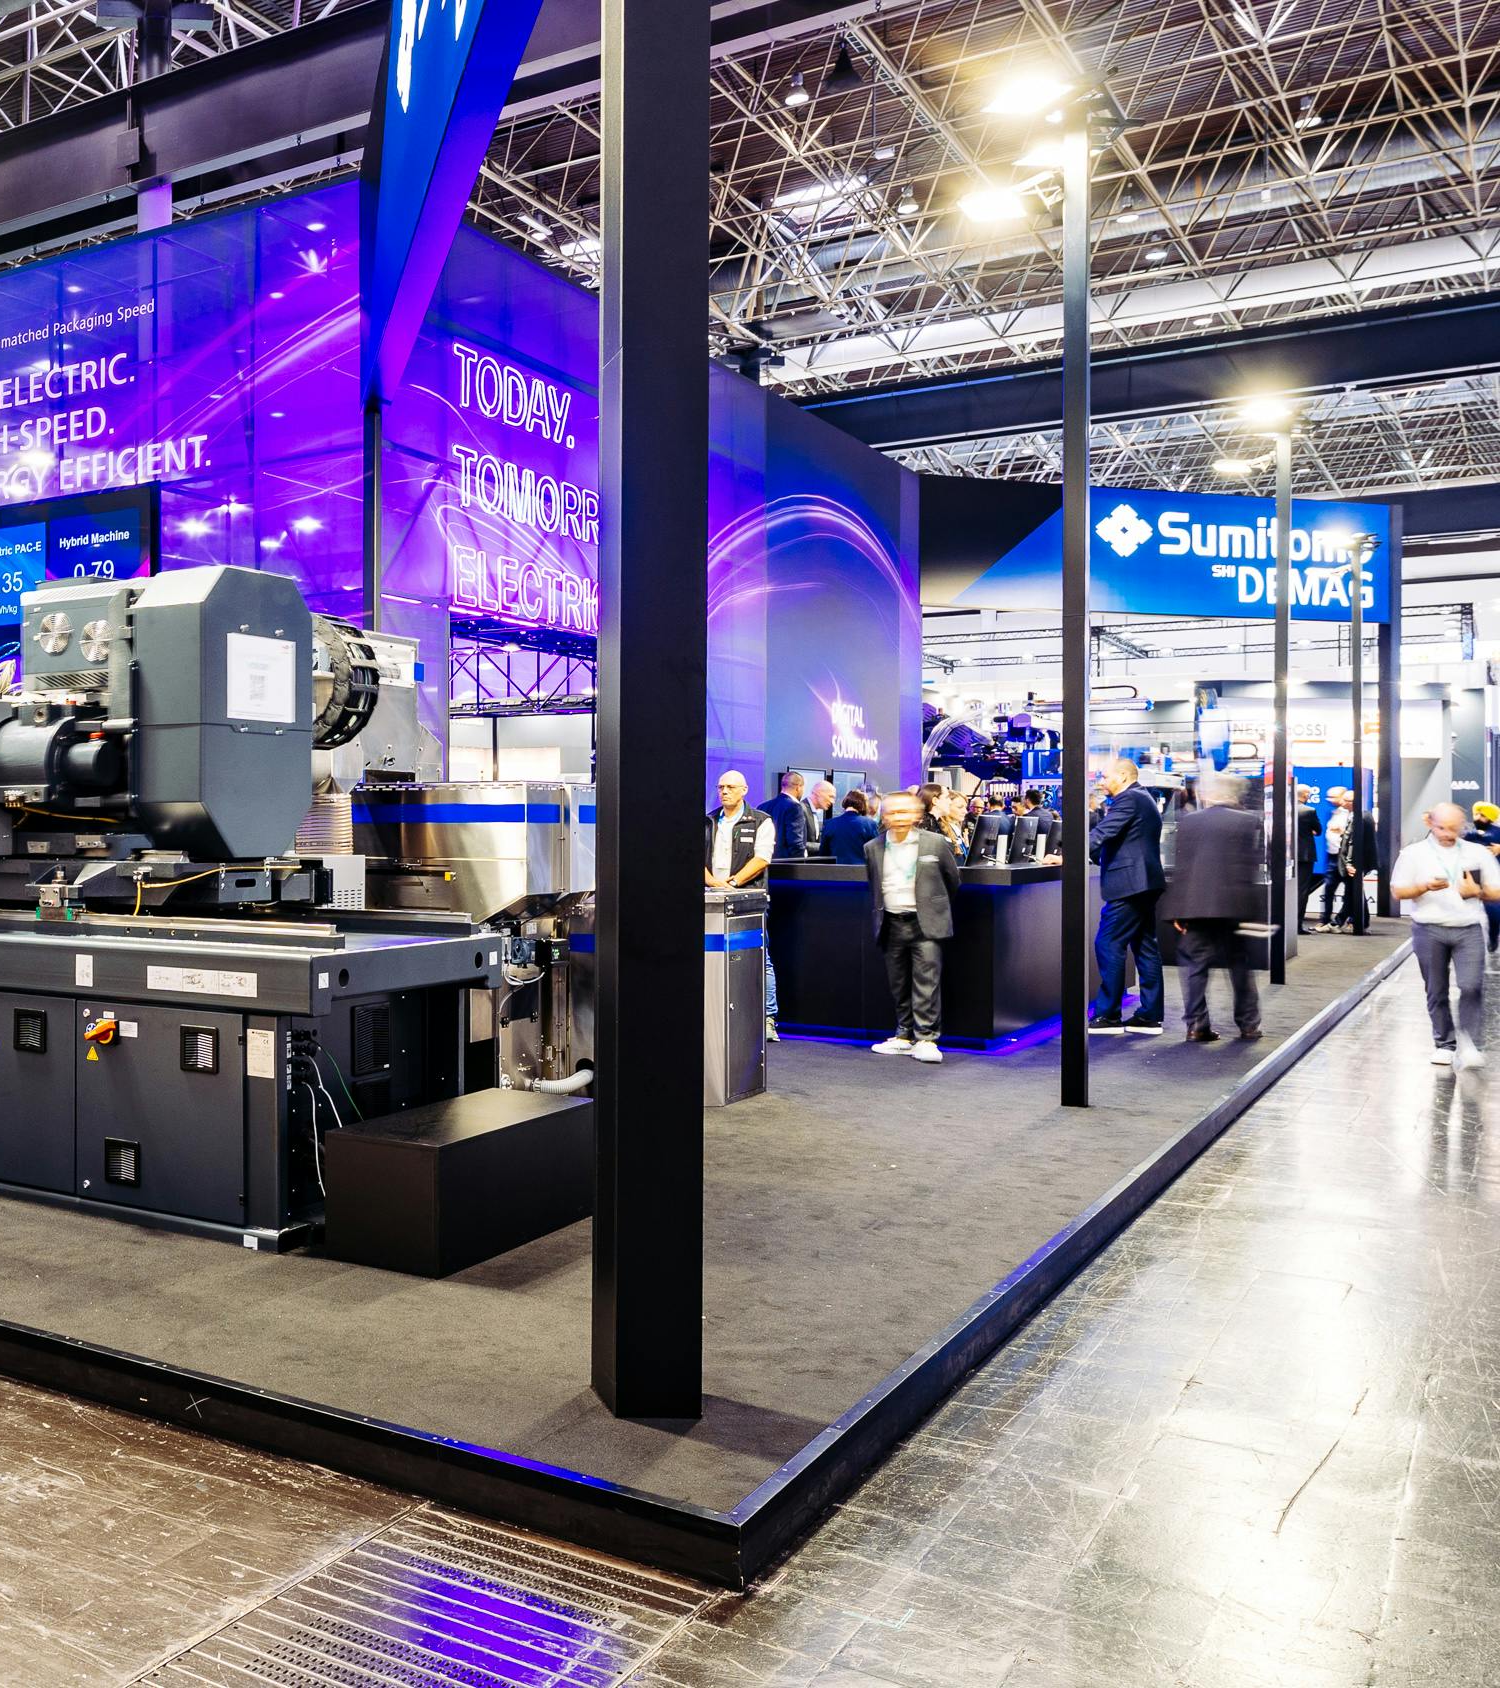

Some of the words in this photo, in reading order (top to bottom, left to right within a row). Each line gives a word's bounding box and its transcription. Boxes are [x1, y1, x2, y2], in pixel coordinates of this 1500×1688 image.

[53, 310, 113, 337] Packaging
[117, 299, 155, 322] Speed
[453, 343, 575, 449] TODAY.
[59, 434, 212, 491] EFFICIENT.
[452, 444, 599, 546] TOMORR
[14, 541, 42, 554] PAC-E
[59, 534, 89, 550] Hybrid
[91, 529, 130, 544] Machine
[452, 544, 599, 630] ELECTRI
[1211, 564, 1237, 578] SHI
[831, 702, 865, 728] DIGITAL
[831, 735, 878, 762] SOLUTIONS
